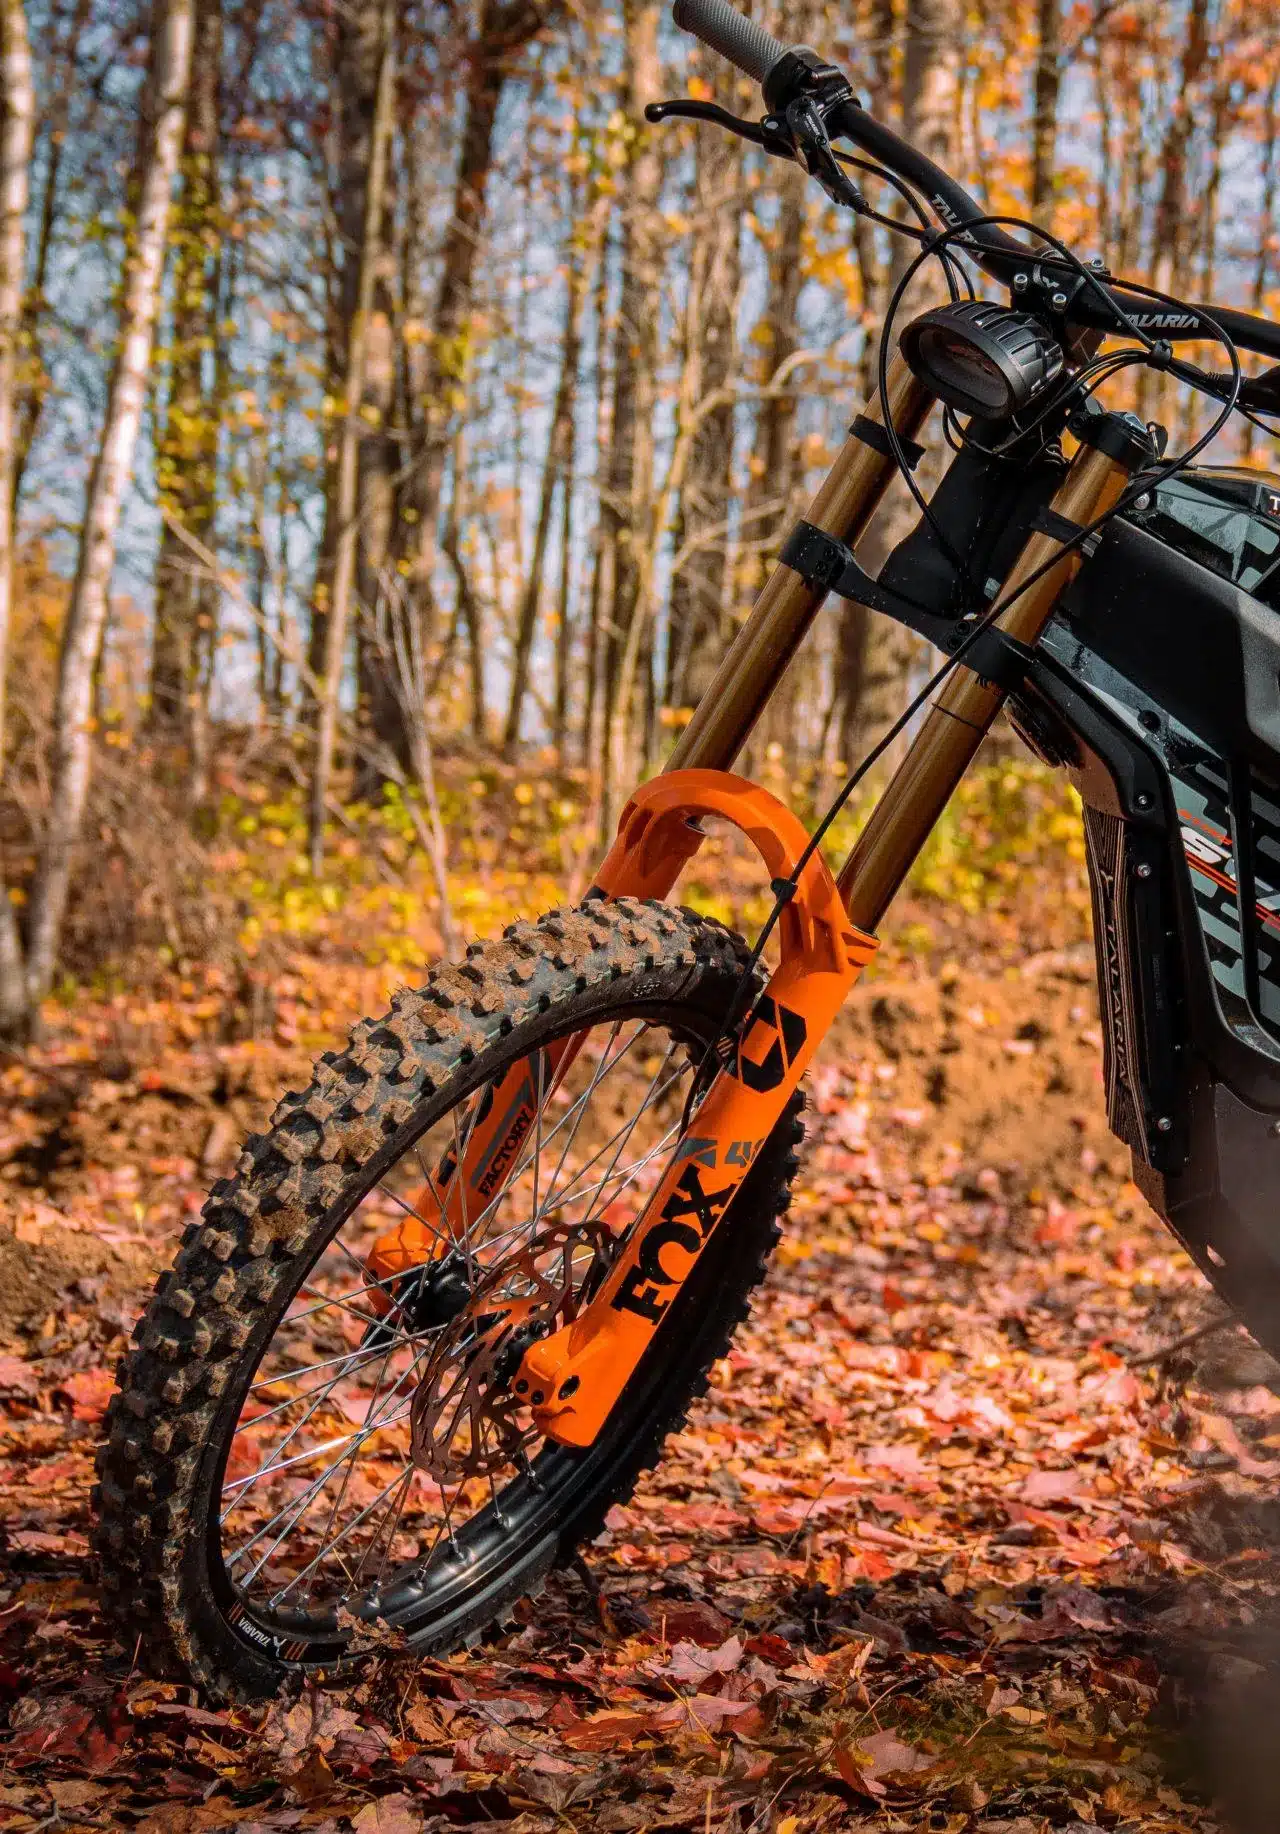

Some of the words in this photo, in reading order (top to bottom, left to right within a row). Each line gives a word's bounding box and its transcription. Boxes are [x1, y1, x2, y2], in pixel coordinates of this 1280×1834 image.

[477, 1109, 531, 1196] FACTORY
[610, 1162, 740, 1326] FOX
[238, 1616, 272, 1648] TALARIA
